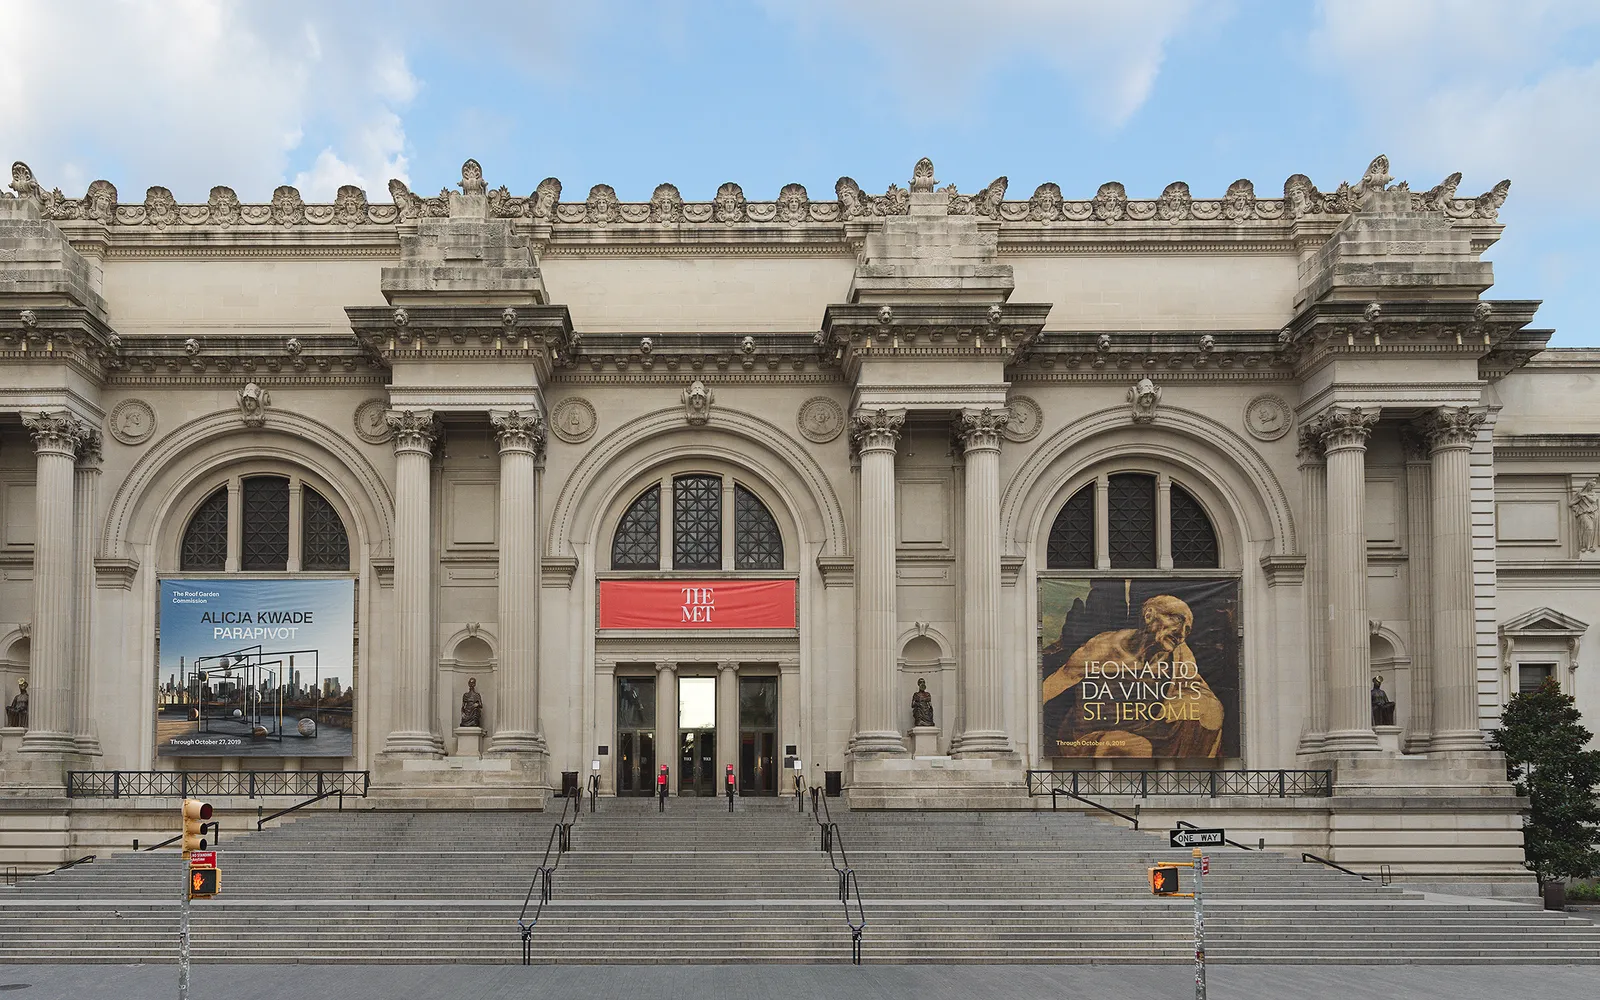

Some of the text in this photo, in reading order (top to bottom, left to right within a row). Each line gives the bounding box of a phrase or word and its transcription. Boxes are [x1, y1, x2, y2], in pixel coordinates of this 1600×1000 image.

[681, 587, 715, 605] THE
[200, 611, 313, 624] ALICJA KWADE
[681, 605, 716, 623] MET
[213, 627, 299, 640] PARAPIVOT
[1084, 660, 1198, 680] LEONARDO
[1082, 681, 1202, 700] DA VINCI'S
[1083, 702, 1200, 725] ST. JEROME
